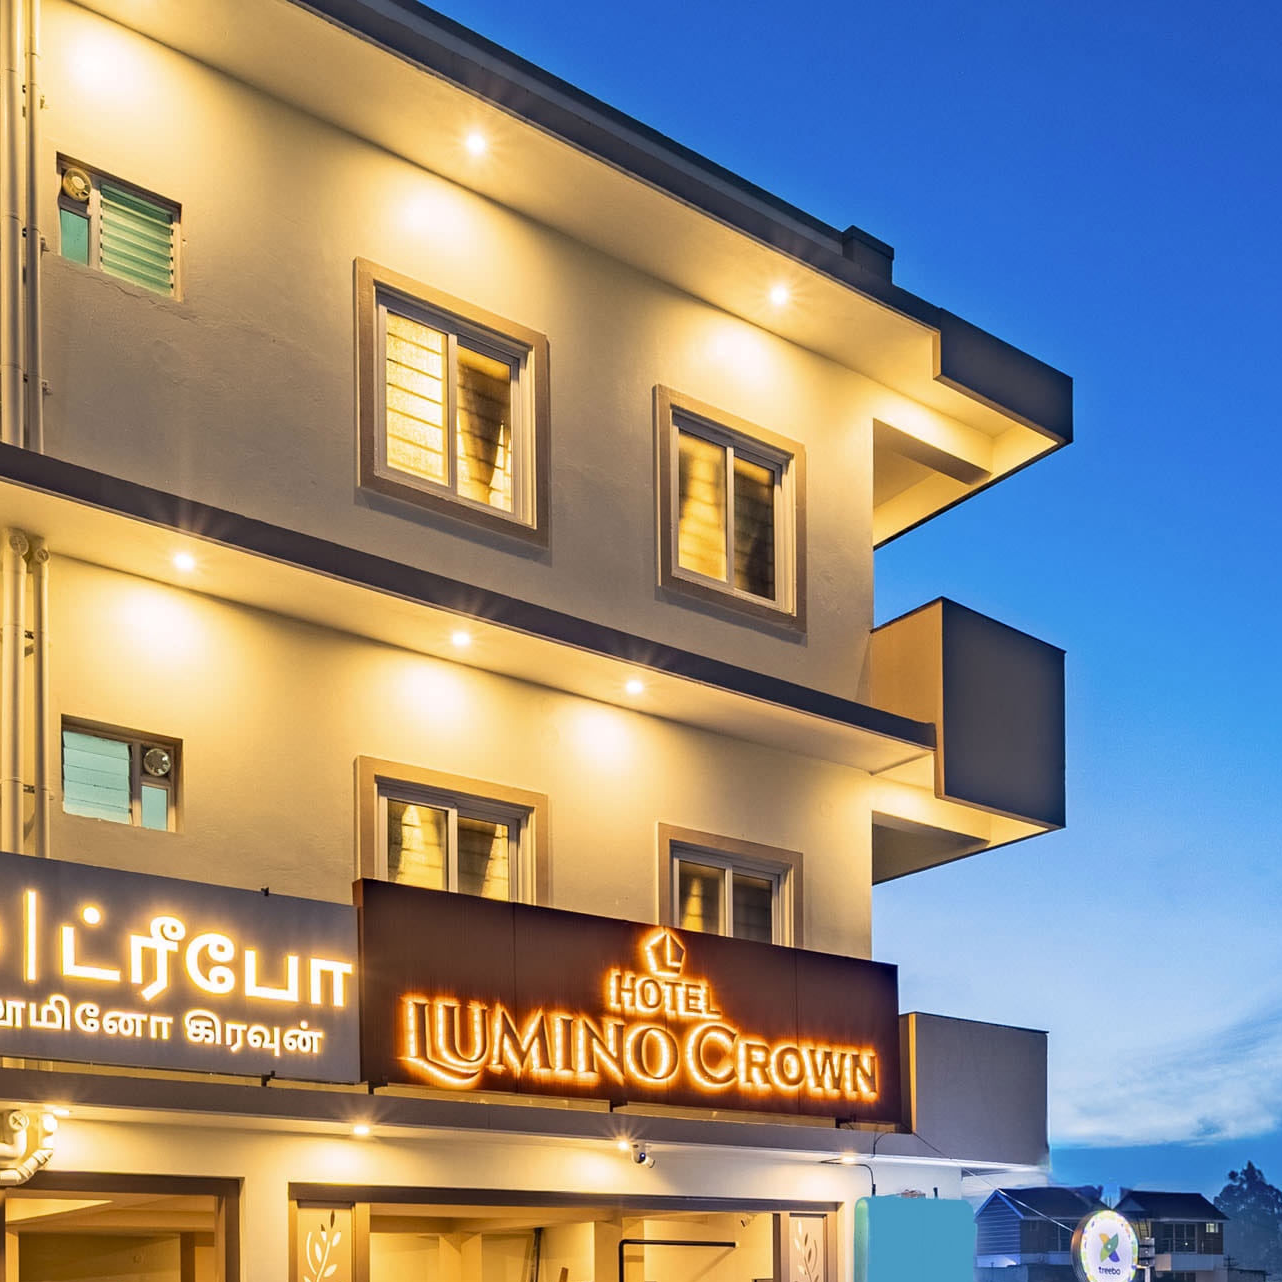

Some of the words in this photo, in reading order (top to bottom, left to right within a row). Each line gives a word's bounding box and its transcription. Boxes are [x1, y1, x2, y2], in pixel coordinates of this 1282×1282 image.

[61, 905, 354, 1008] ட்ரீபோ
[610, 971, 722, 1018] HOTEL
[183, 1009, 324, 1057] கிரவுன்
[403, 997, 680, 1086] LUMINO
[688, 1021, 879, 1098] CROWN
[1098, 1266, 1121, 1275] treebo
